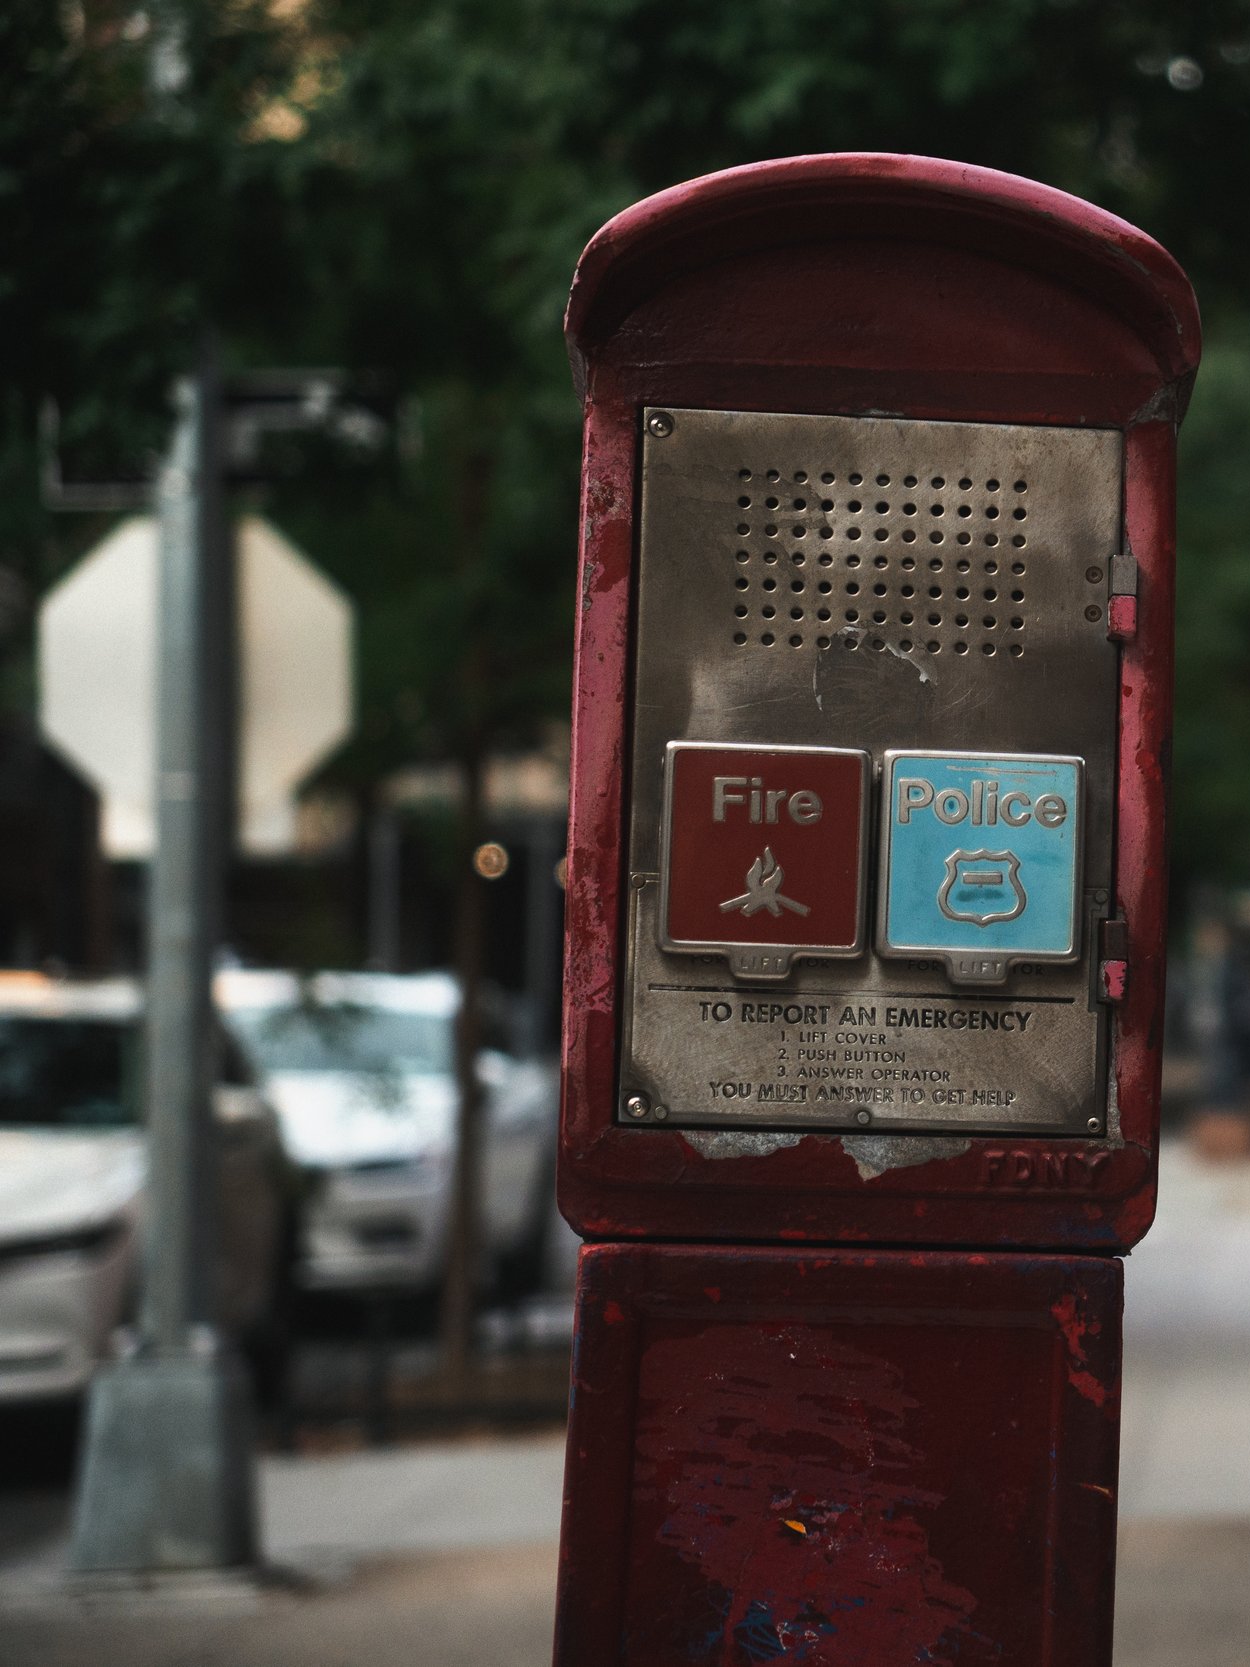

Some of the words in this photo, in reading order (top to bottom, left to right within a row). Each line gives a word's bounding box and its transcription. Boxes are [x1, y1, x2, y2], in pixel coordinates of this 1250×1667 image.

[712, 776, 824, 825] Fire
[897, 778, 1068, 829] Police
[740, 956, 783, 970] LIFT
[959, 961, 1002, 975] LIFT
[699, 1002, 732, 1022] TO
[741, 1003, 831, 1025] REPORT
[839, 1006, 876, 1026] AN
[886, 1007, 1032, 1031] EMERGENCY
[780, 1031, 790, 1043] 1.
[799, 1031, 828, 1043] LIFT
[835, 1032, 887, 1045] COVER
[778, 1048, 789, 1060] 2.
[798, 1049, 836, 1062] PUSH
[844, 1050, 906, 1063] BUTTON
[777, 1066, 788, 1077] 3.
[797, 1067, 864, 1080] ANSWER
[871, 1068, 950, 1083] OPERATOR
[709, 1082, 752, 1099] YOU
[758, 1083, 808, 1101] MUST
[816, 1085, 894, 1103] ANSWER
[901, 1087, 925, 1104] TO
[932, 1088, 966, 1105] GET
[973, 1089, 1017, 1107] HELP
[978, 1151, 1111, 1188] FDNY
